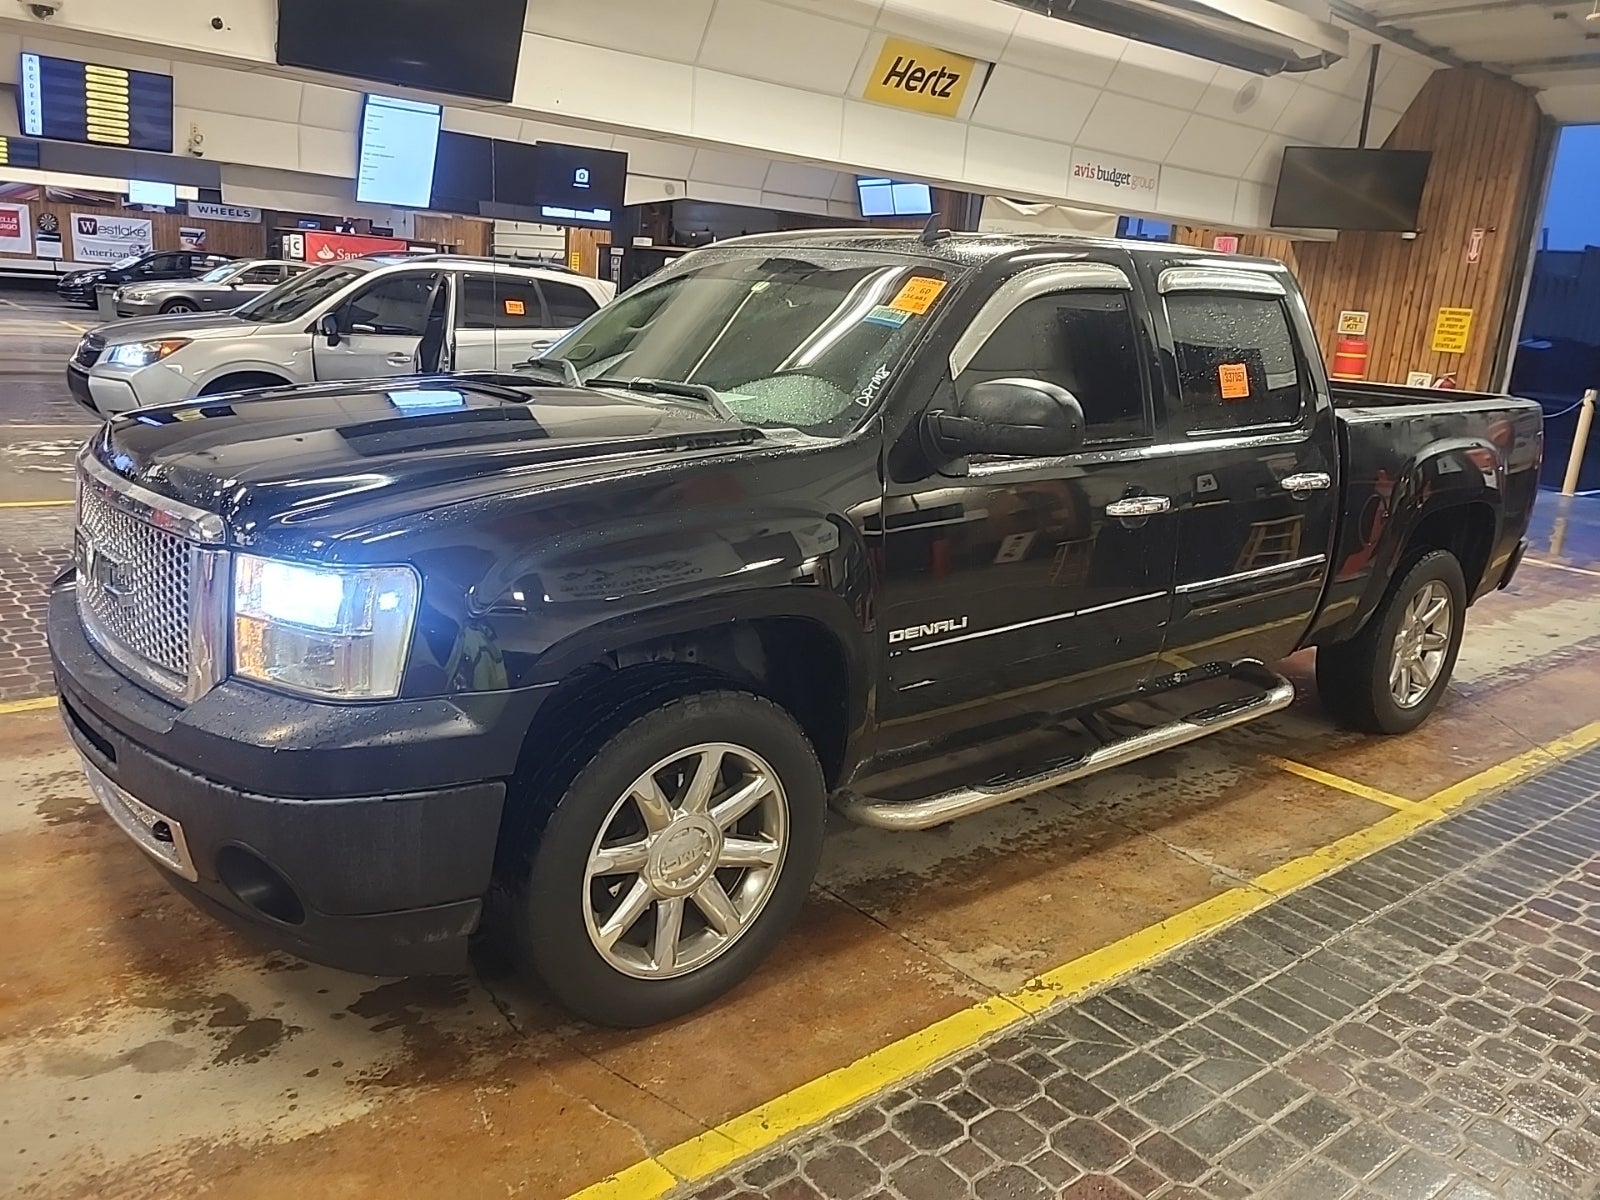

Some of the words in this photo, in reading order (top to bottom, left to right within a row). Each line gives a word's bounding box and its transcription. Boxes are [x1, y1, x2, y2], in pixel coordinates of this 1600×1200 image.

[881, 56, 960, 98] Hertz
[1073, 162, 1096, 179] avis
[1096, 168, 1131, 187] budget
[1131, 174, 1156, 191] group
[198, 206, 251, 217] WHEELS
[80, 220, 147, 237] Westlake
[81, 246, 129, 258] American
[888, 616, 968, 644] DENALI
